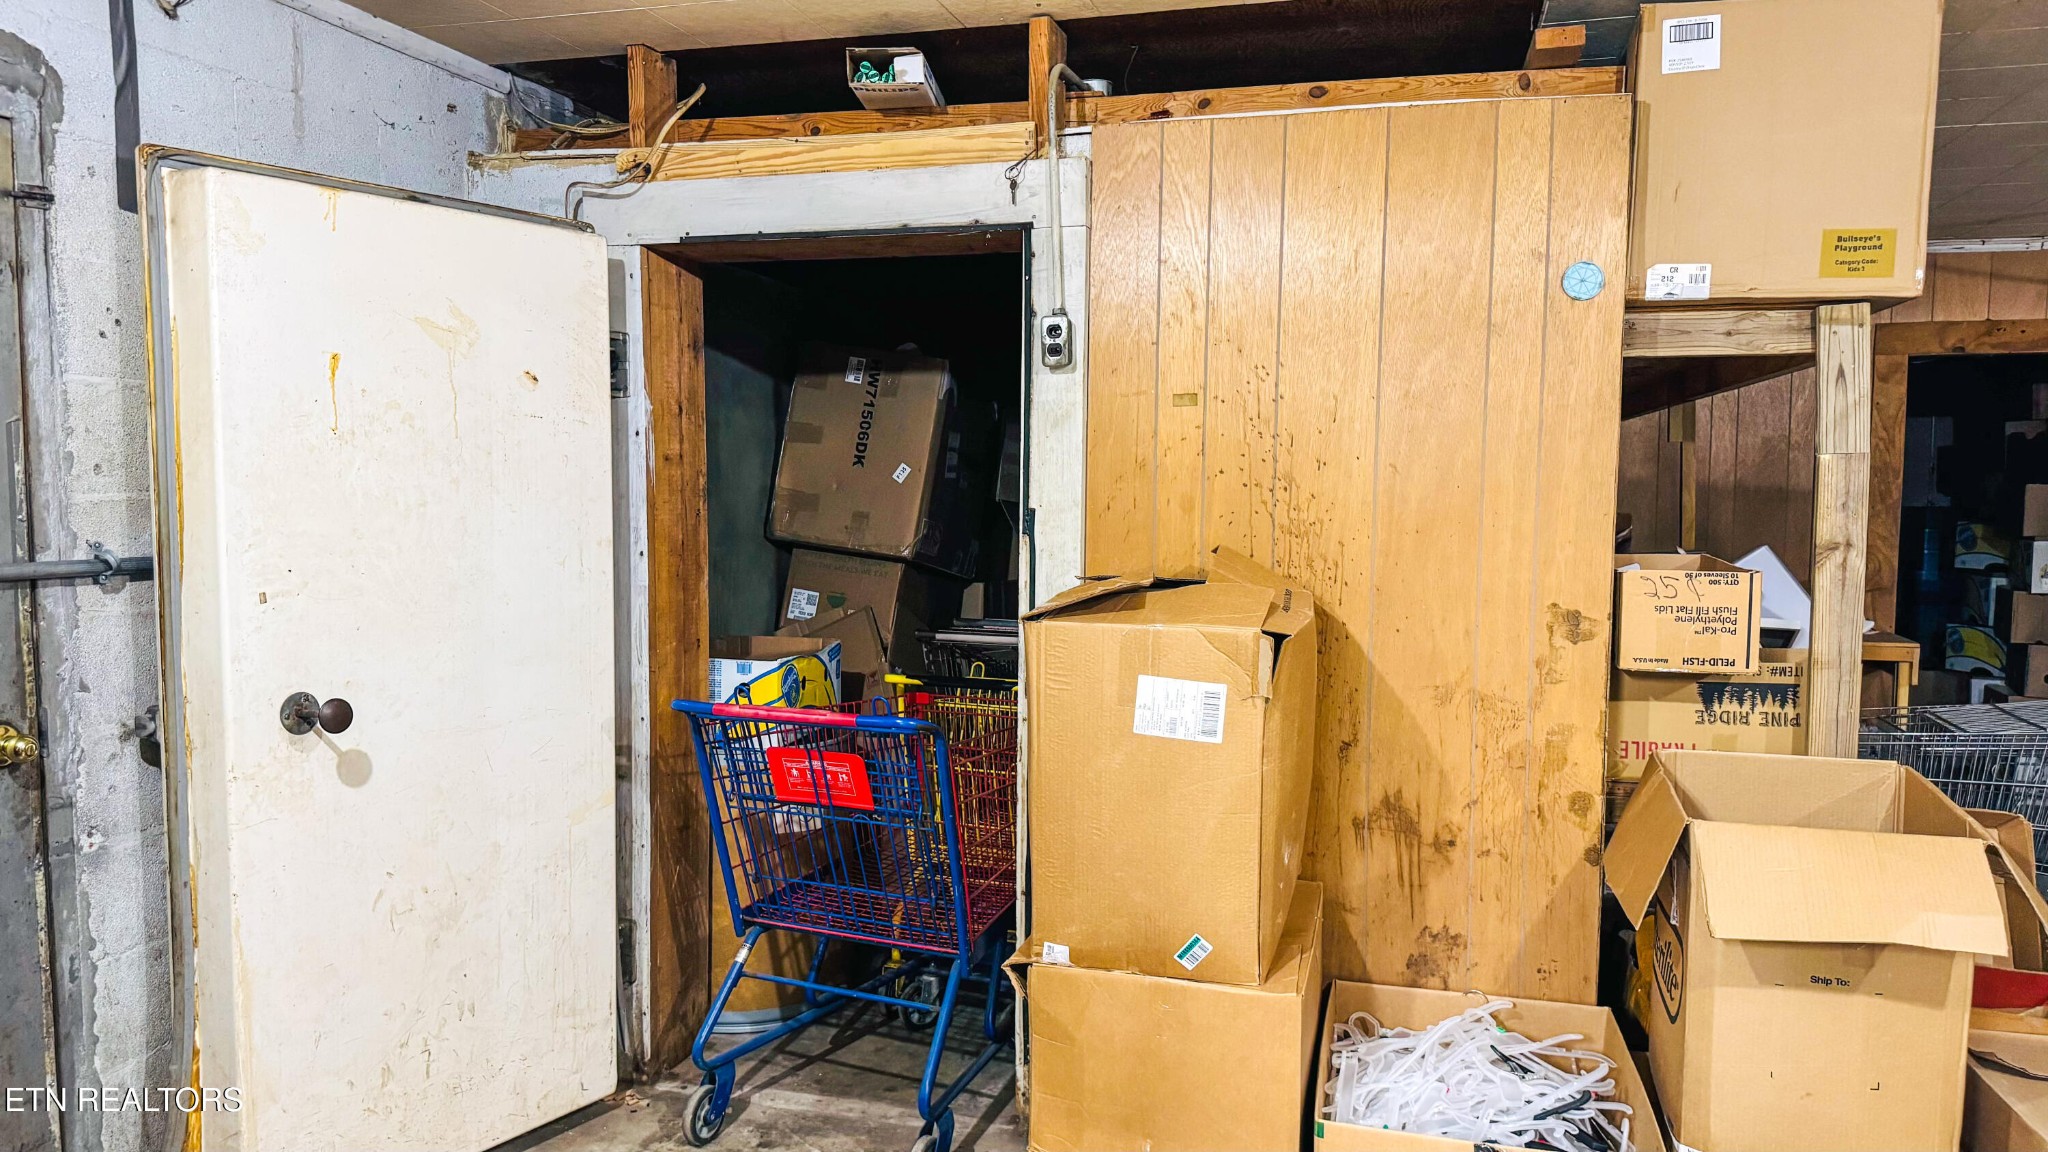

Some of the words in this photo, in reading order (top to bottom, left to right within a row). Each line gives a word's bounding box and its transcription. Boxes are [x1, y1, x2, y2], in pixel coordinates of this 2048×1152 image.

[1837, 235, 1881, 243] Bullseye's
[1834, 243, 1883, 252] Playground
[1722, 578, 1740, 586] QTY:
[1654, 605, 1674, 615] Lids
[1676, 605, 1694, 615] Flat
[1695, 606, 1710, 616] Fill
[1712, 606, 1738, 616] Flush
[1674, 613, 1738, 625] Polyethylene
[1682, 657, 1736, 667] PELID-FLSH
[1766, 666, 1804, 678] ITEM#:
[1695, 710, 1750, 727] RIDGE
[1758, 711, 1801, 728] PINE
[1810, 975, 1833, 987] Ship
[1834, 977, 1850, 987] To:
